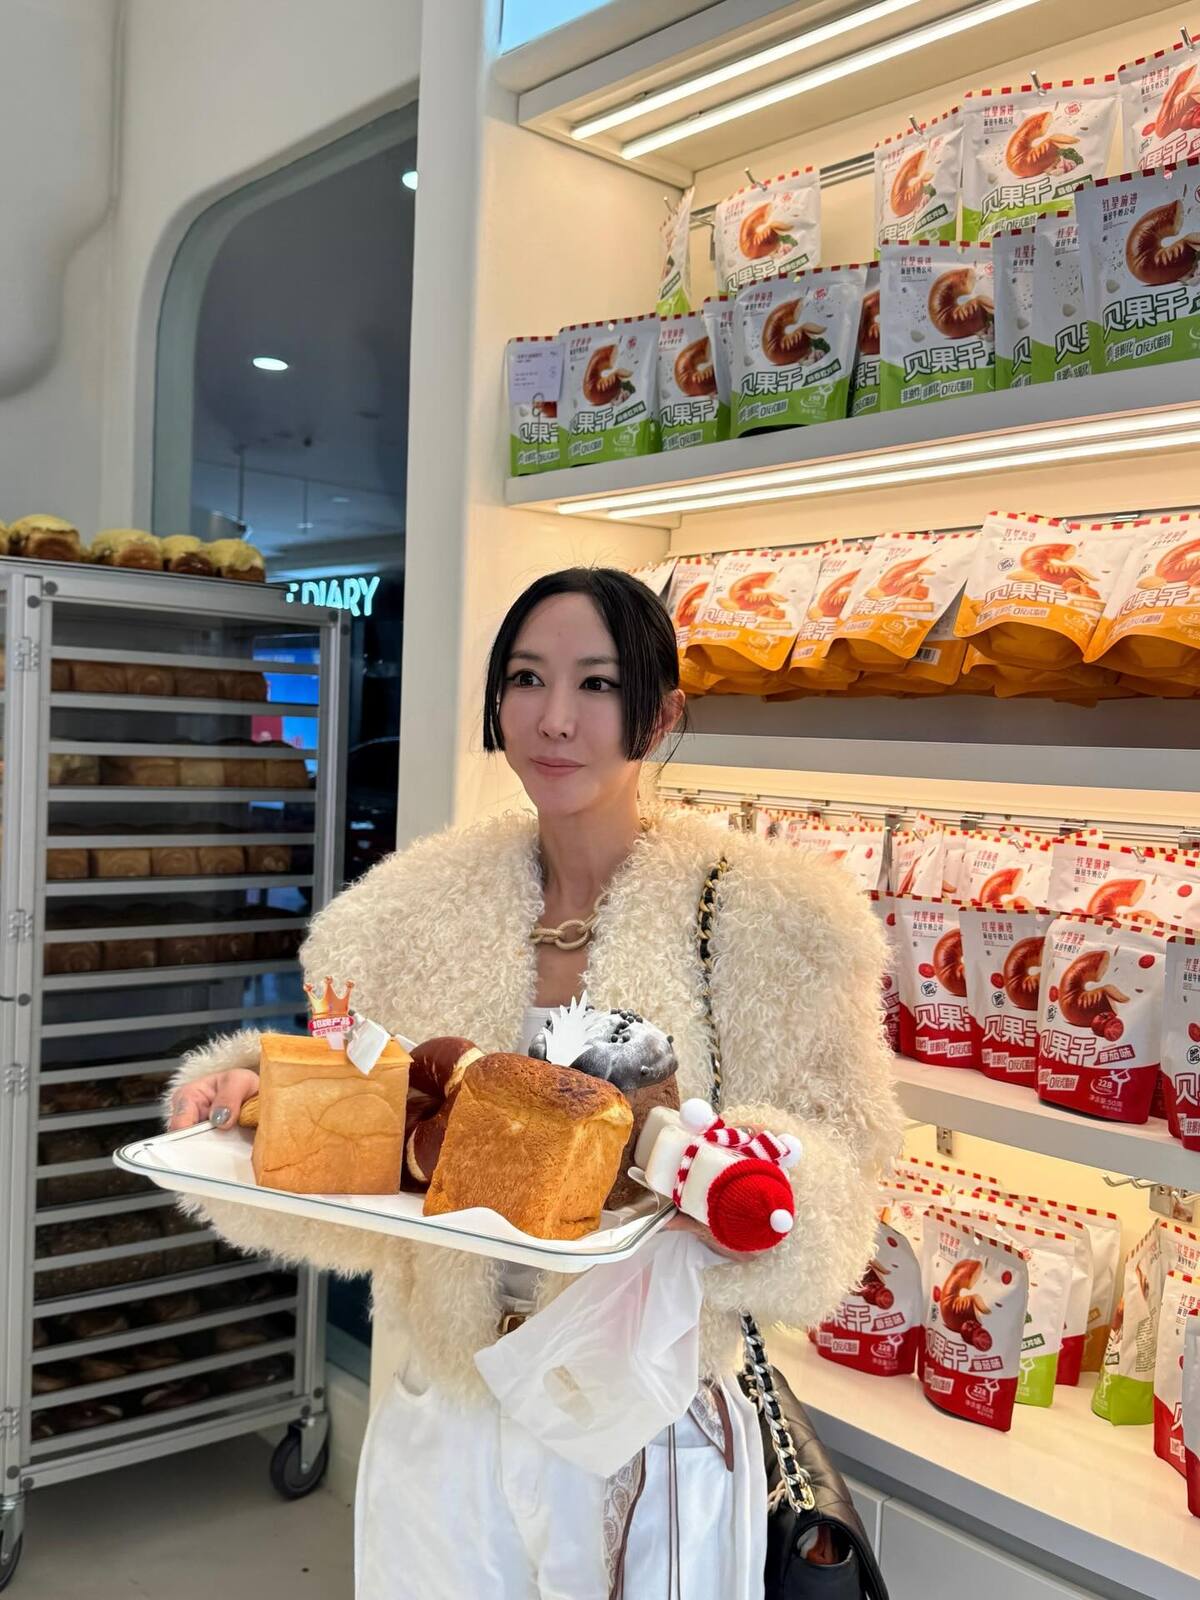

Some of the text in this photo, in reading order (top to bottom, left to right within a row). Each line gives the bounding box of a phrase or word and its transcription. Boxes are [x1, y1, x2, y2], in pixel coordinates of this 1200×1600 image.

[980, 177, 1052, 224] 贝果干
[1102, 287, 1189, 341] 贝果干
[903, 340, 985, 382] 贝果干
[739, 367, 803, 408] 贝果干
[983, 582, 1068, 608] 贝果干
